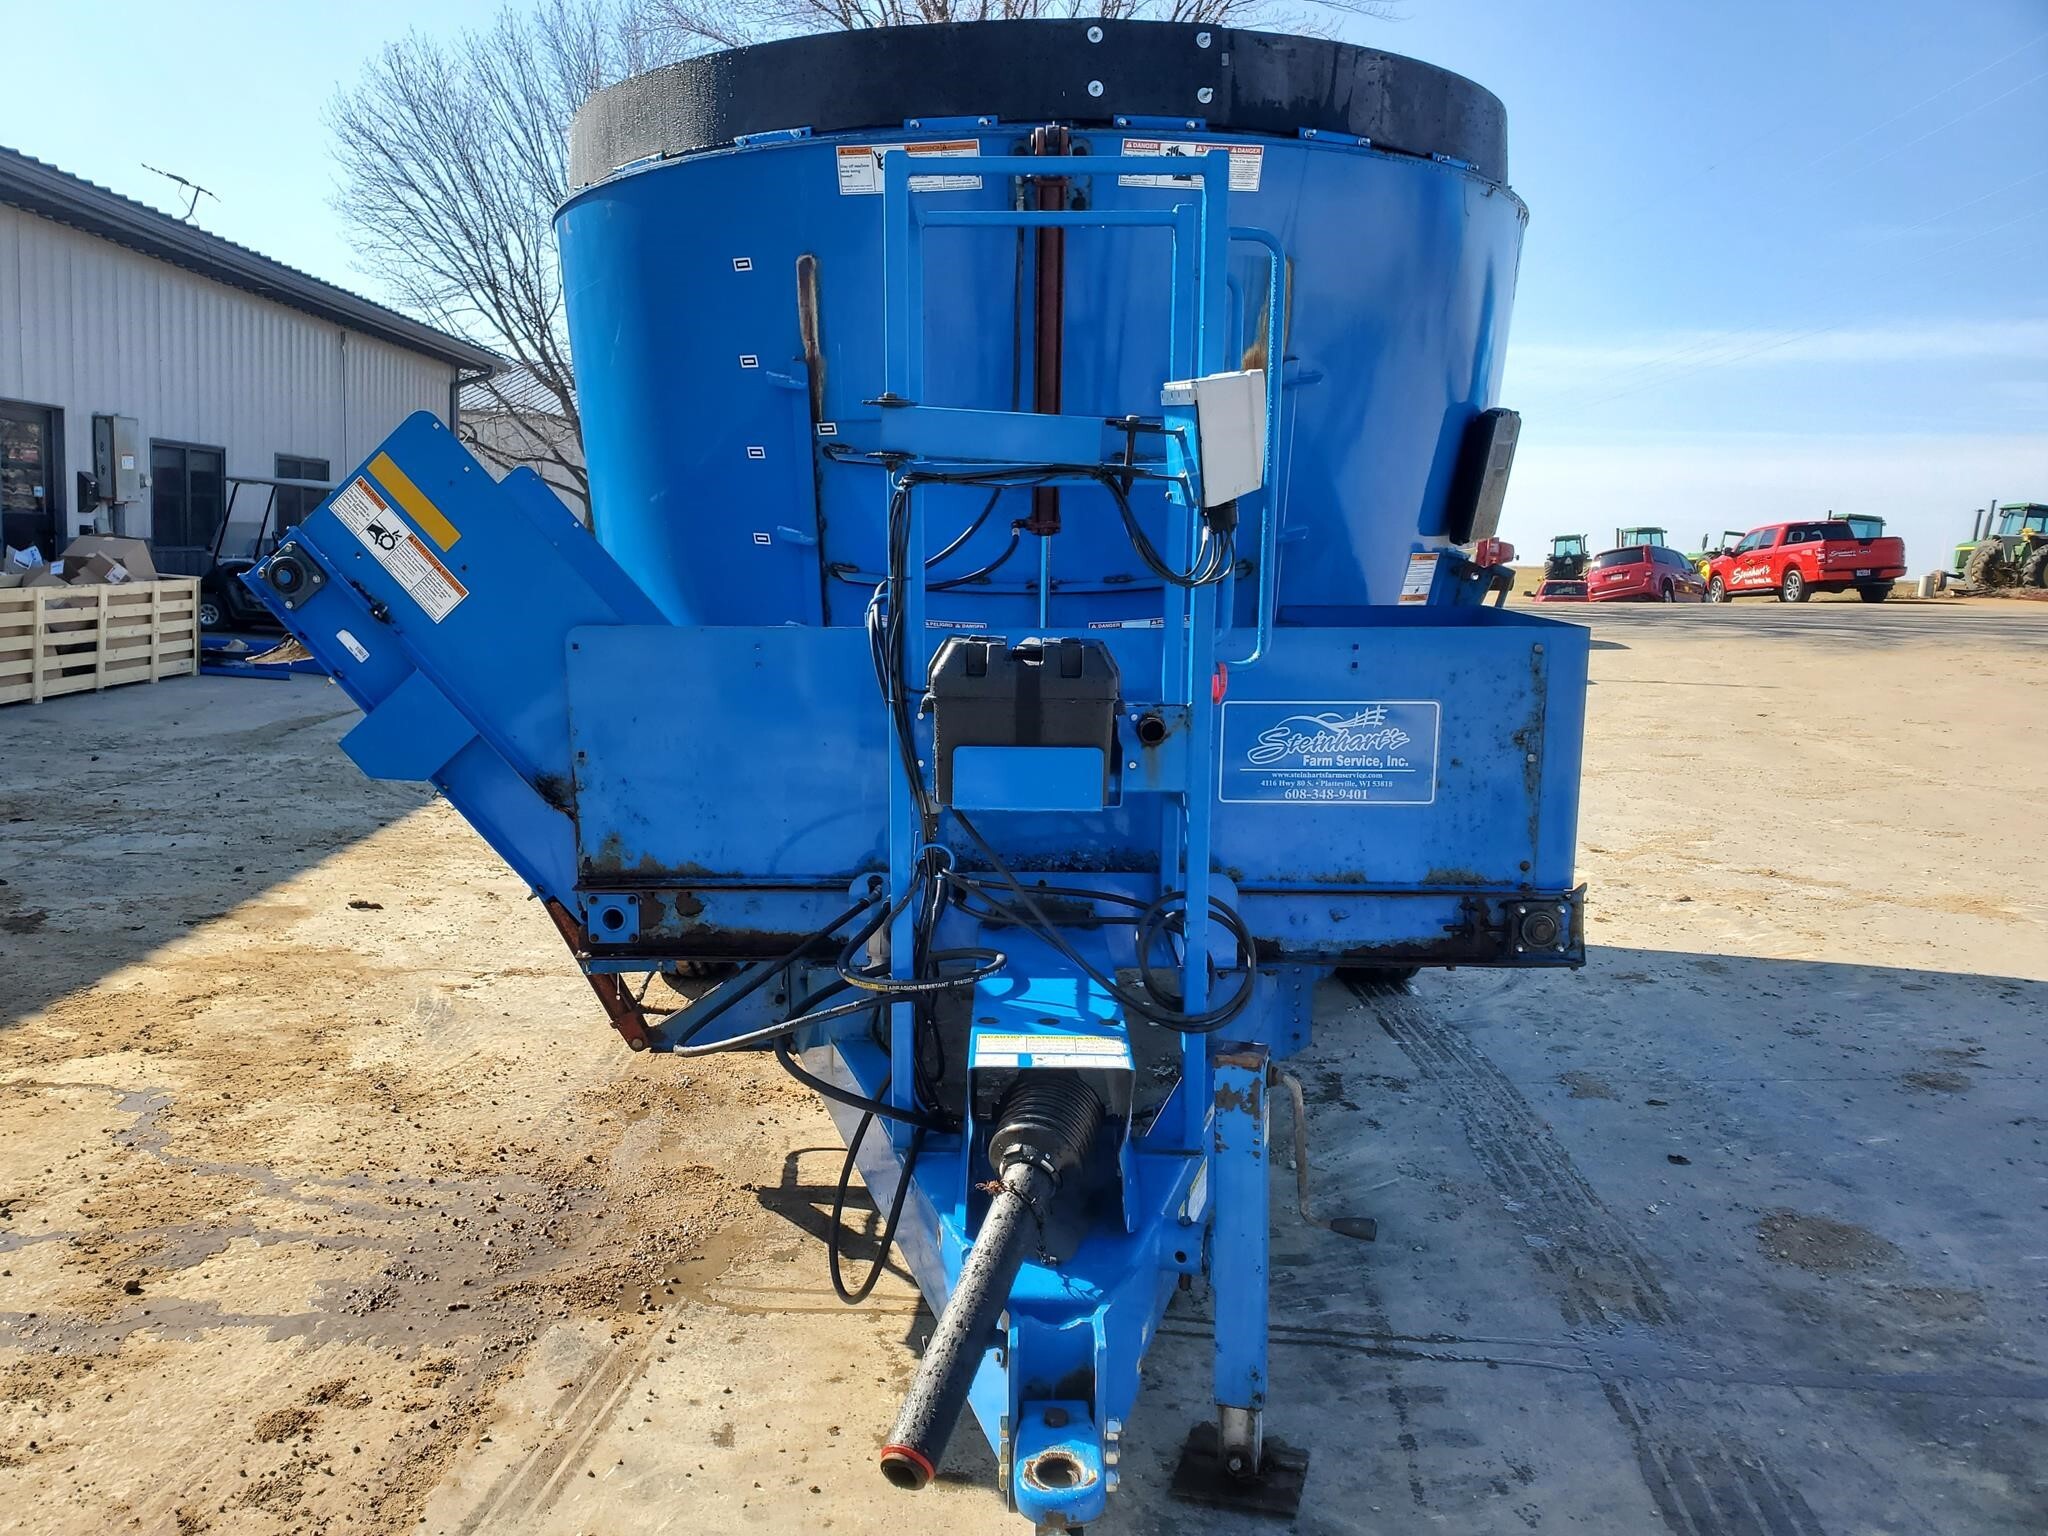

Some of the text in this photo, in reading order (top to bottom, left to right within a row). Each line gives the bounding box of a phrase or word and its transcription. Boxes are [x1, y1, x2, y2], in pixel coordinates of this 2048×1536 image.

[1248, 727, 1410, 765] Steinhart's
[1303, 755, 1409, 768] Farm Service, Inc.
[1279, 780, 1295, 788] Hwy
[1284, 788, 1368, 800] 608-348-9401
[918, 982, 950, 991] RESISTANT
